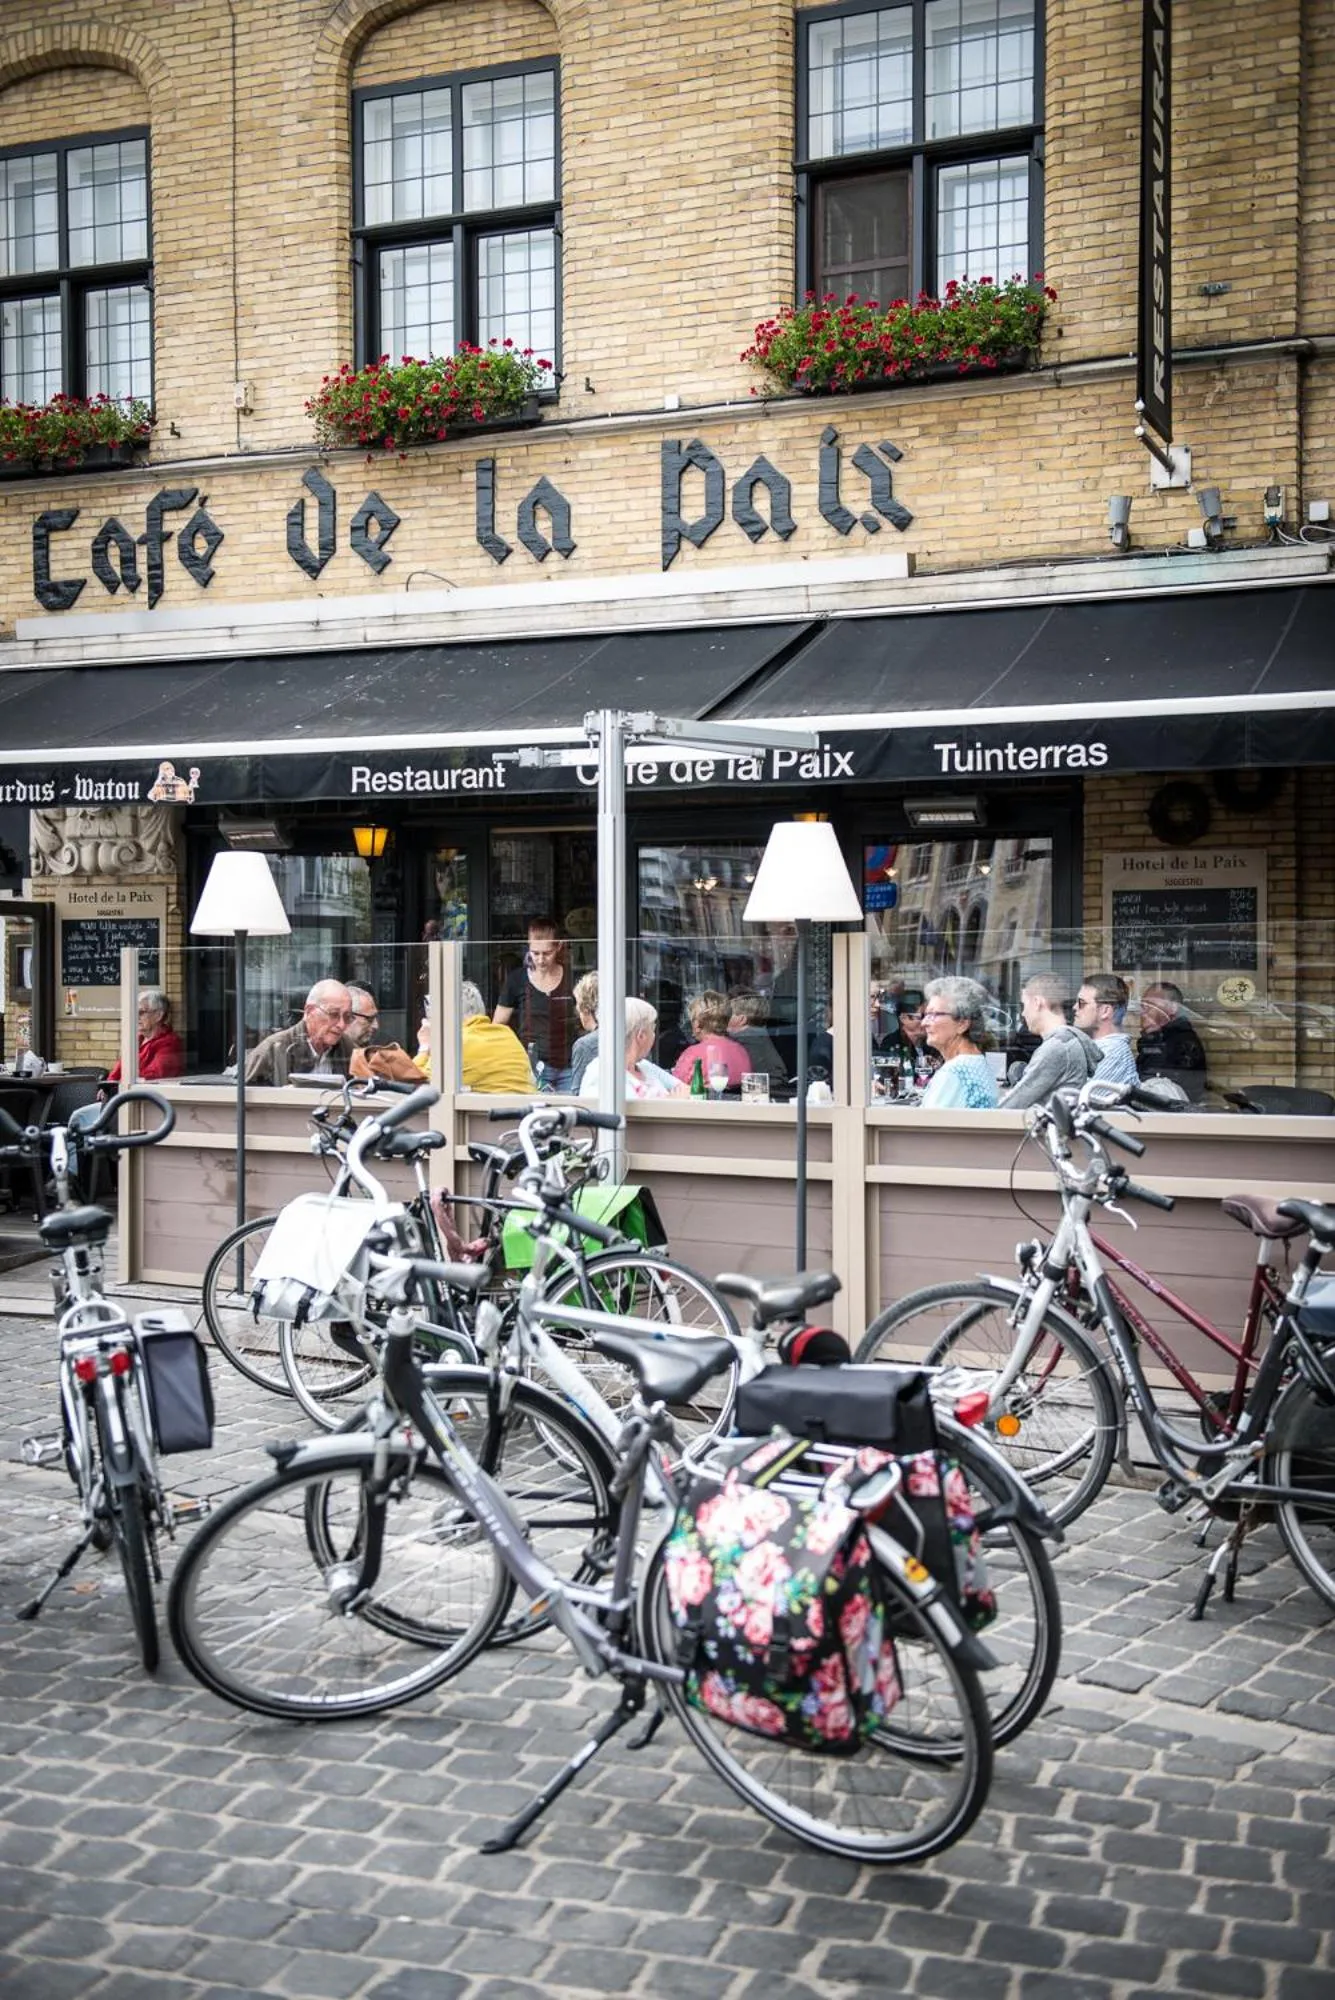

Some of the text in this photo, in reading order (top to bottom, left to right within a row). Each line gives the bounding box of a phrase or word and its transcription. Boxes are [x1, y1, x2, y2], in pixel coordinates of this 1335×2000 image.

[286, 465, 402, 580] de
[475, 457, 578, 565] la
[772, 744, 855, 780] Paix
[933, 741, 1109, 773] Tuinterras
[74, 773, 140, 801] Watou
[350, 761, 506, 794] Restaurant
[1122, 854, 1248, 871] Hotel de la Paix
[68, 891, 154, 904] Hotel de la Paix
